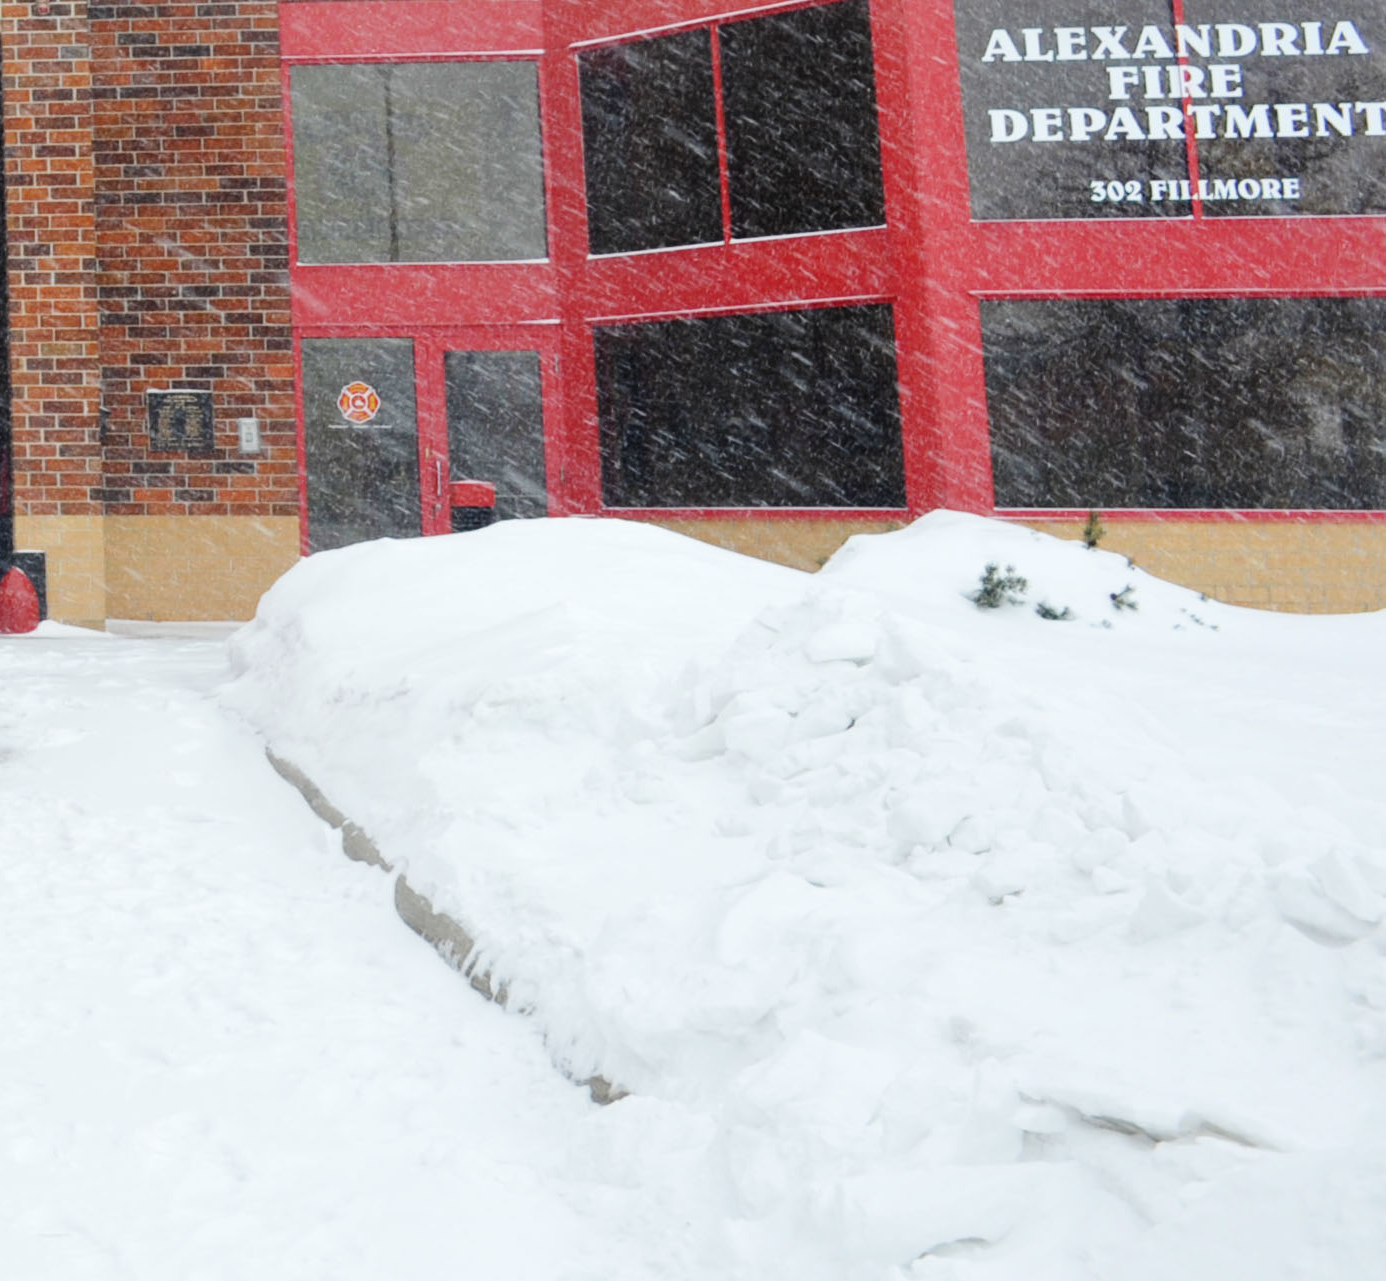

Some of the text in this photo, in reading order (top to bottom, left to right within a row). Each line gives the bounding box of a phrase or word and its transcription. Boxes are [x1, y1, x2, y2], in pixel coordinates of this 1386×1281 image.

[981, 21, 1370, 63] ALEXANDRIA
[1106, 64, 1243, 101] FIRE
[988, 101, 1386, 143] DEPARTMENT
[1090, 177, 1301, 202] 302 FILLMORE
